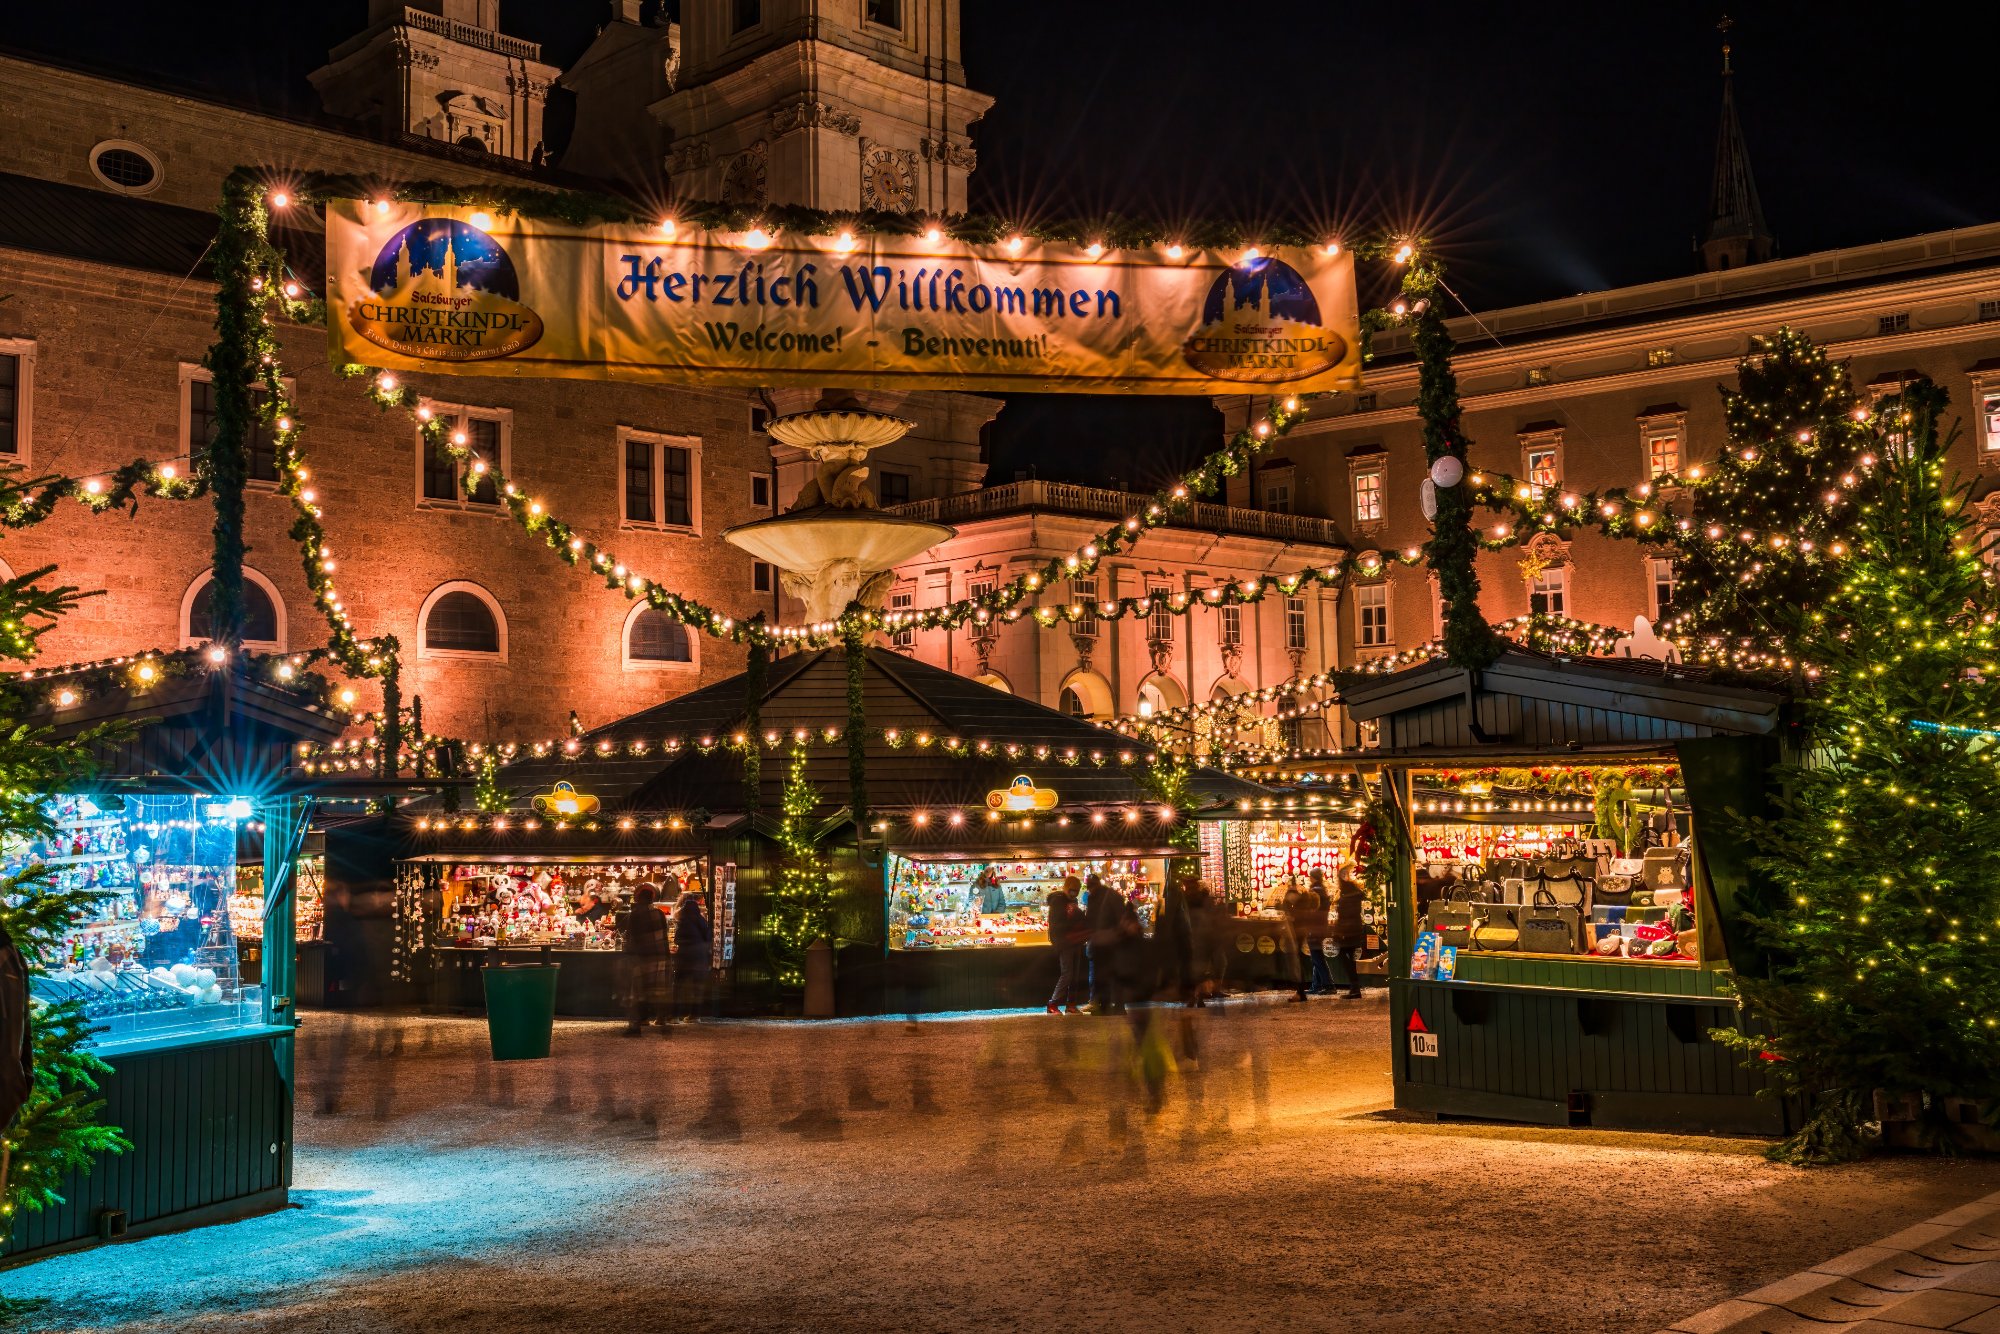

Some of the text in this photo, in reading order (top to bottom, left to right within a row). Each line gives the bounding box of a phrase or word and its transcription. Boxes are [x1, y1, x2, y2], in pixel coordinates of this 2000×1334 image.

[616, 254, 1121, 318] Herzlich Willkommen
[411, 291, 472, 310] Salzburger
[358, 303, 530, 332] CHRISTKINDL-
[401, 325, 487, 346] MARKT
[704, 321, 843, 353] Welcome!
[901, 326, 1048, 359] Benvenuti!
[1234, 324, 1283, 338] Salzburger
[1190, 336, 1336, 353] CHRISTKINDL-
[1228, 354, 1298, 369] MARKT
[990, 796, 1002, 804] 85
[1412, 1035, 1425, 1053] 10
